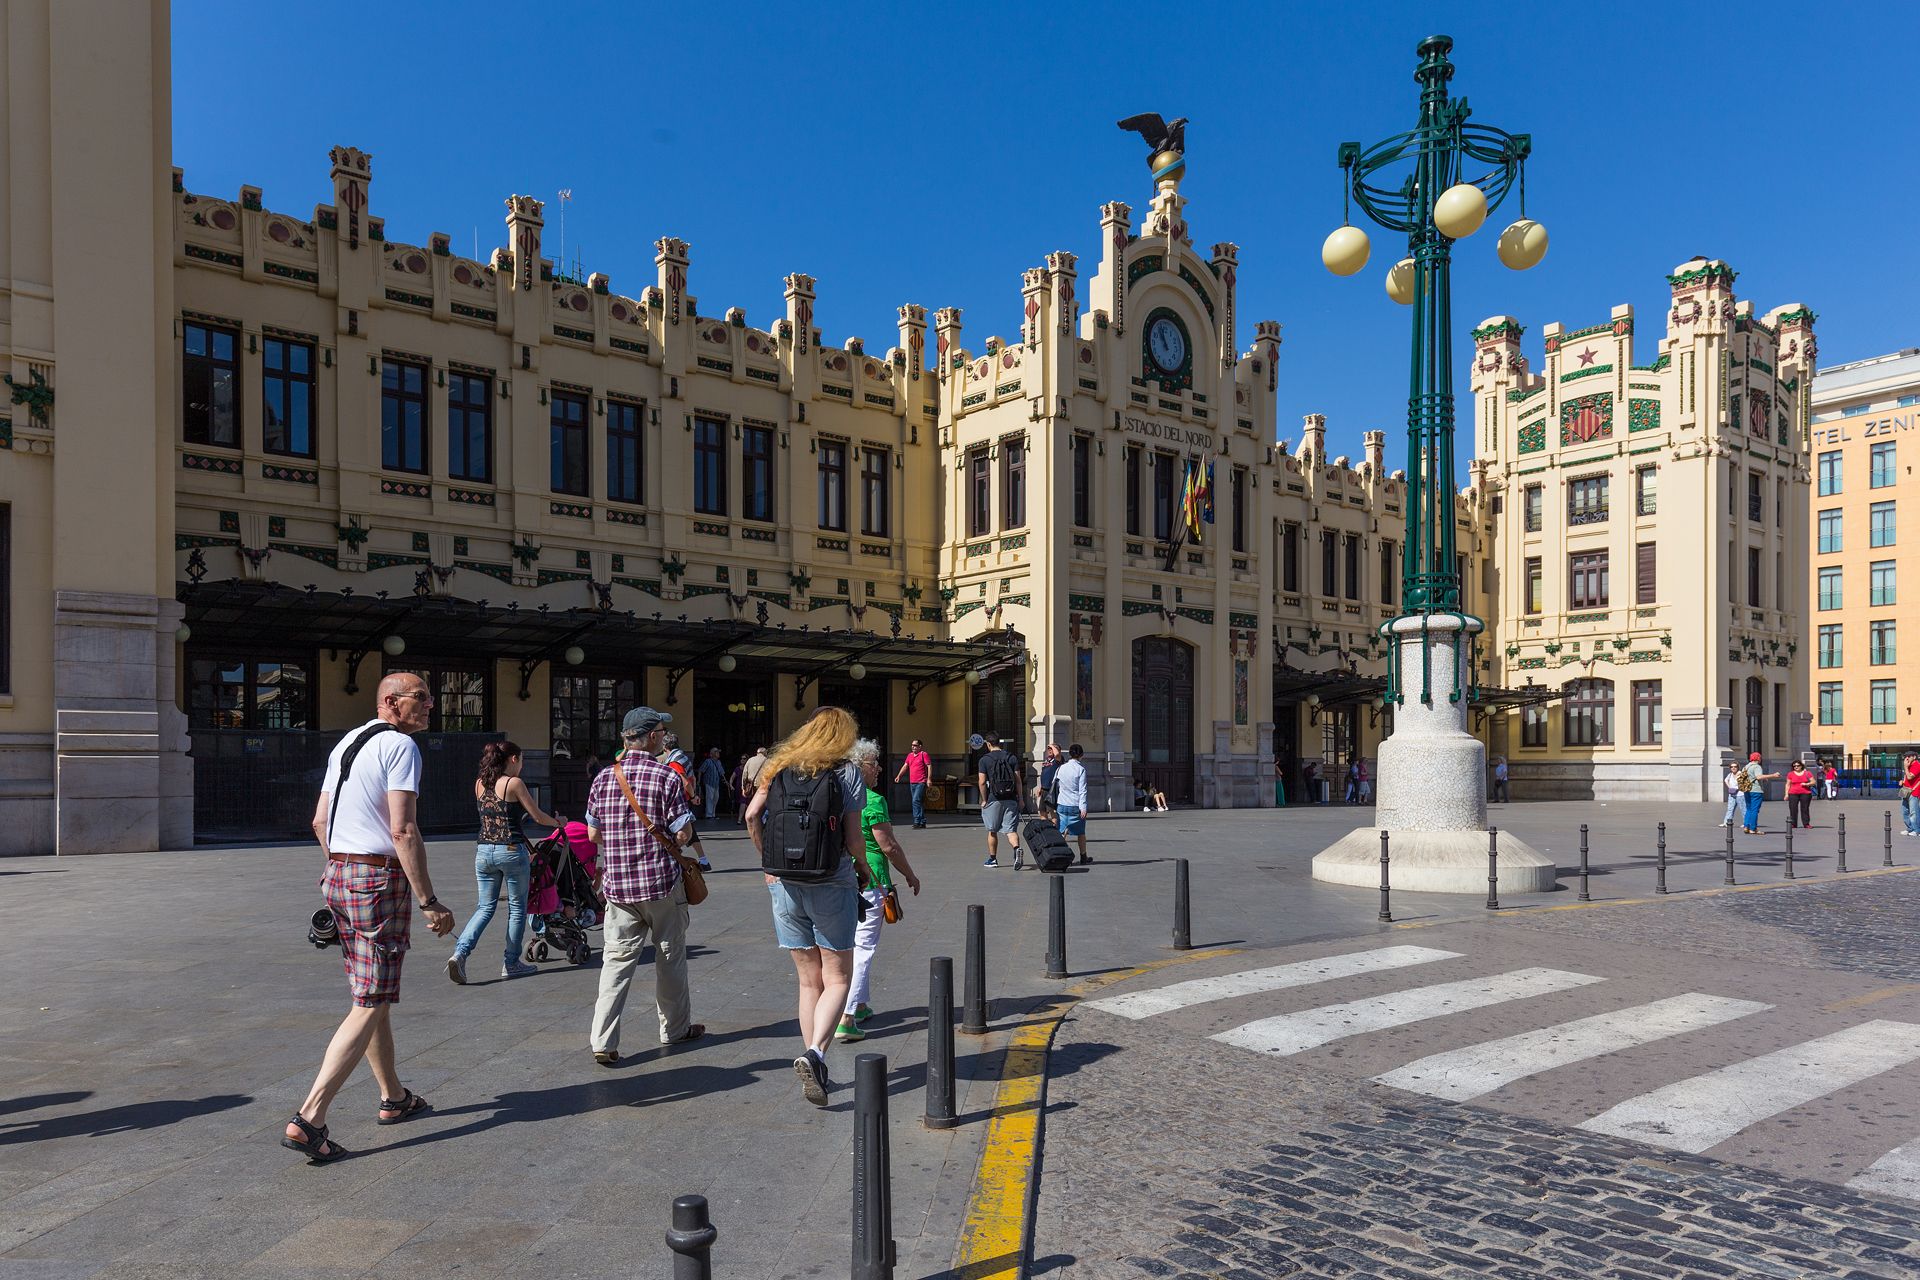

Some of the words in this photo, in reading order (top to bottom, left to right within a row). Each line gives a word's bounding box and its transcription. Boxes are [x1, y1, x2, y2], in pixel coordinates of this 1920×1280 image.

[1864, 413, 1920, 438] ZENI
[1164, 426, 1184, 443] DEL
[1185, 430, 1212, 448] NORD
[246, 738, 264, 746] SPV
